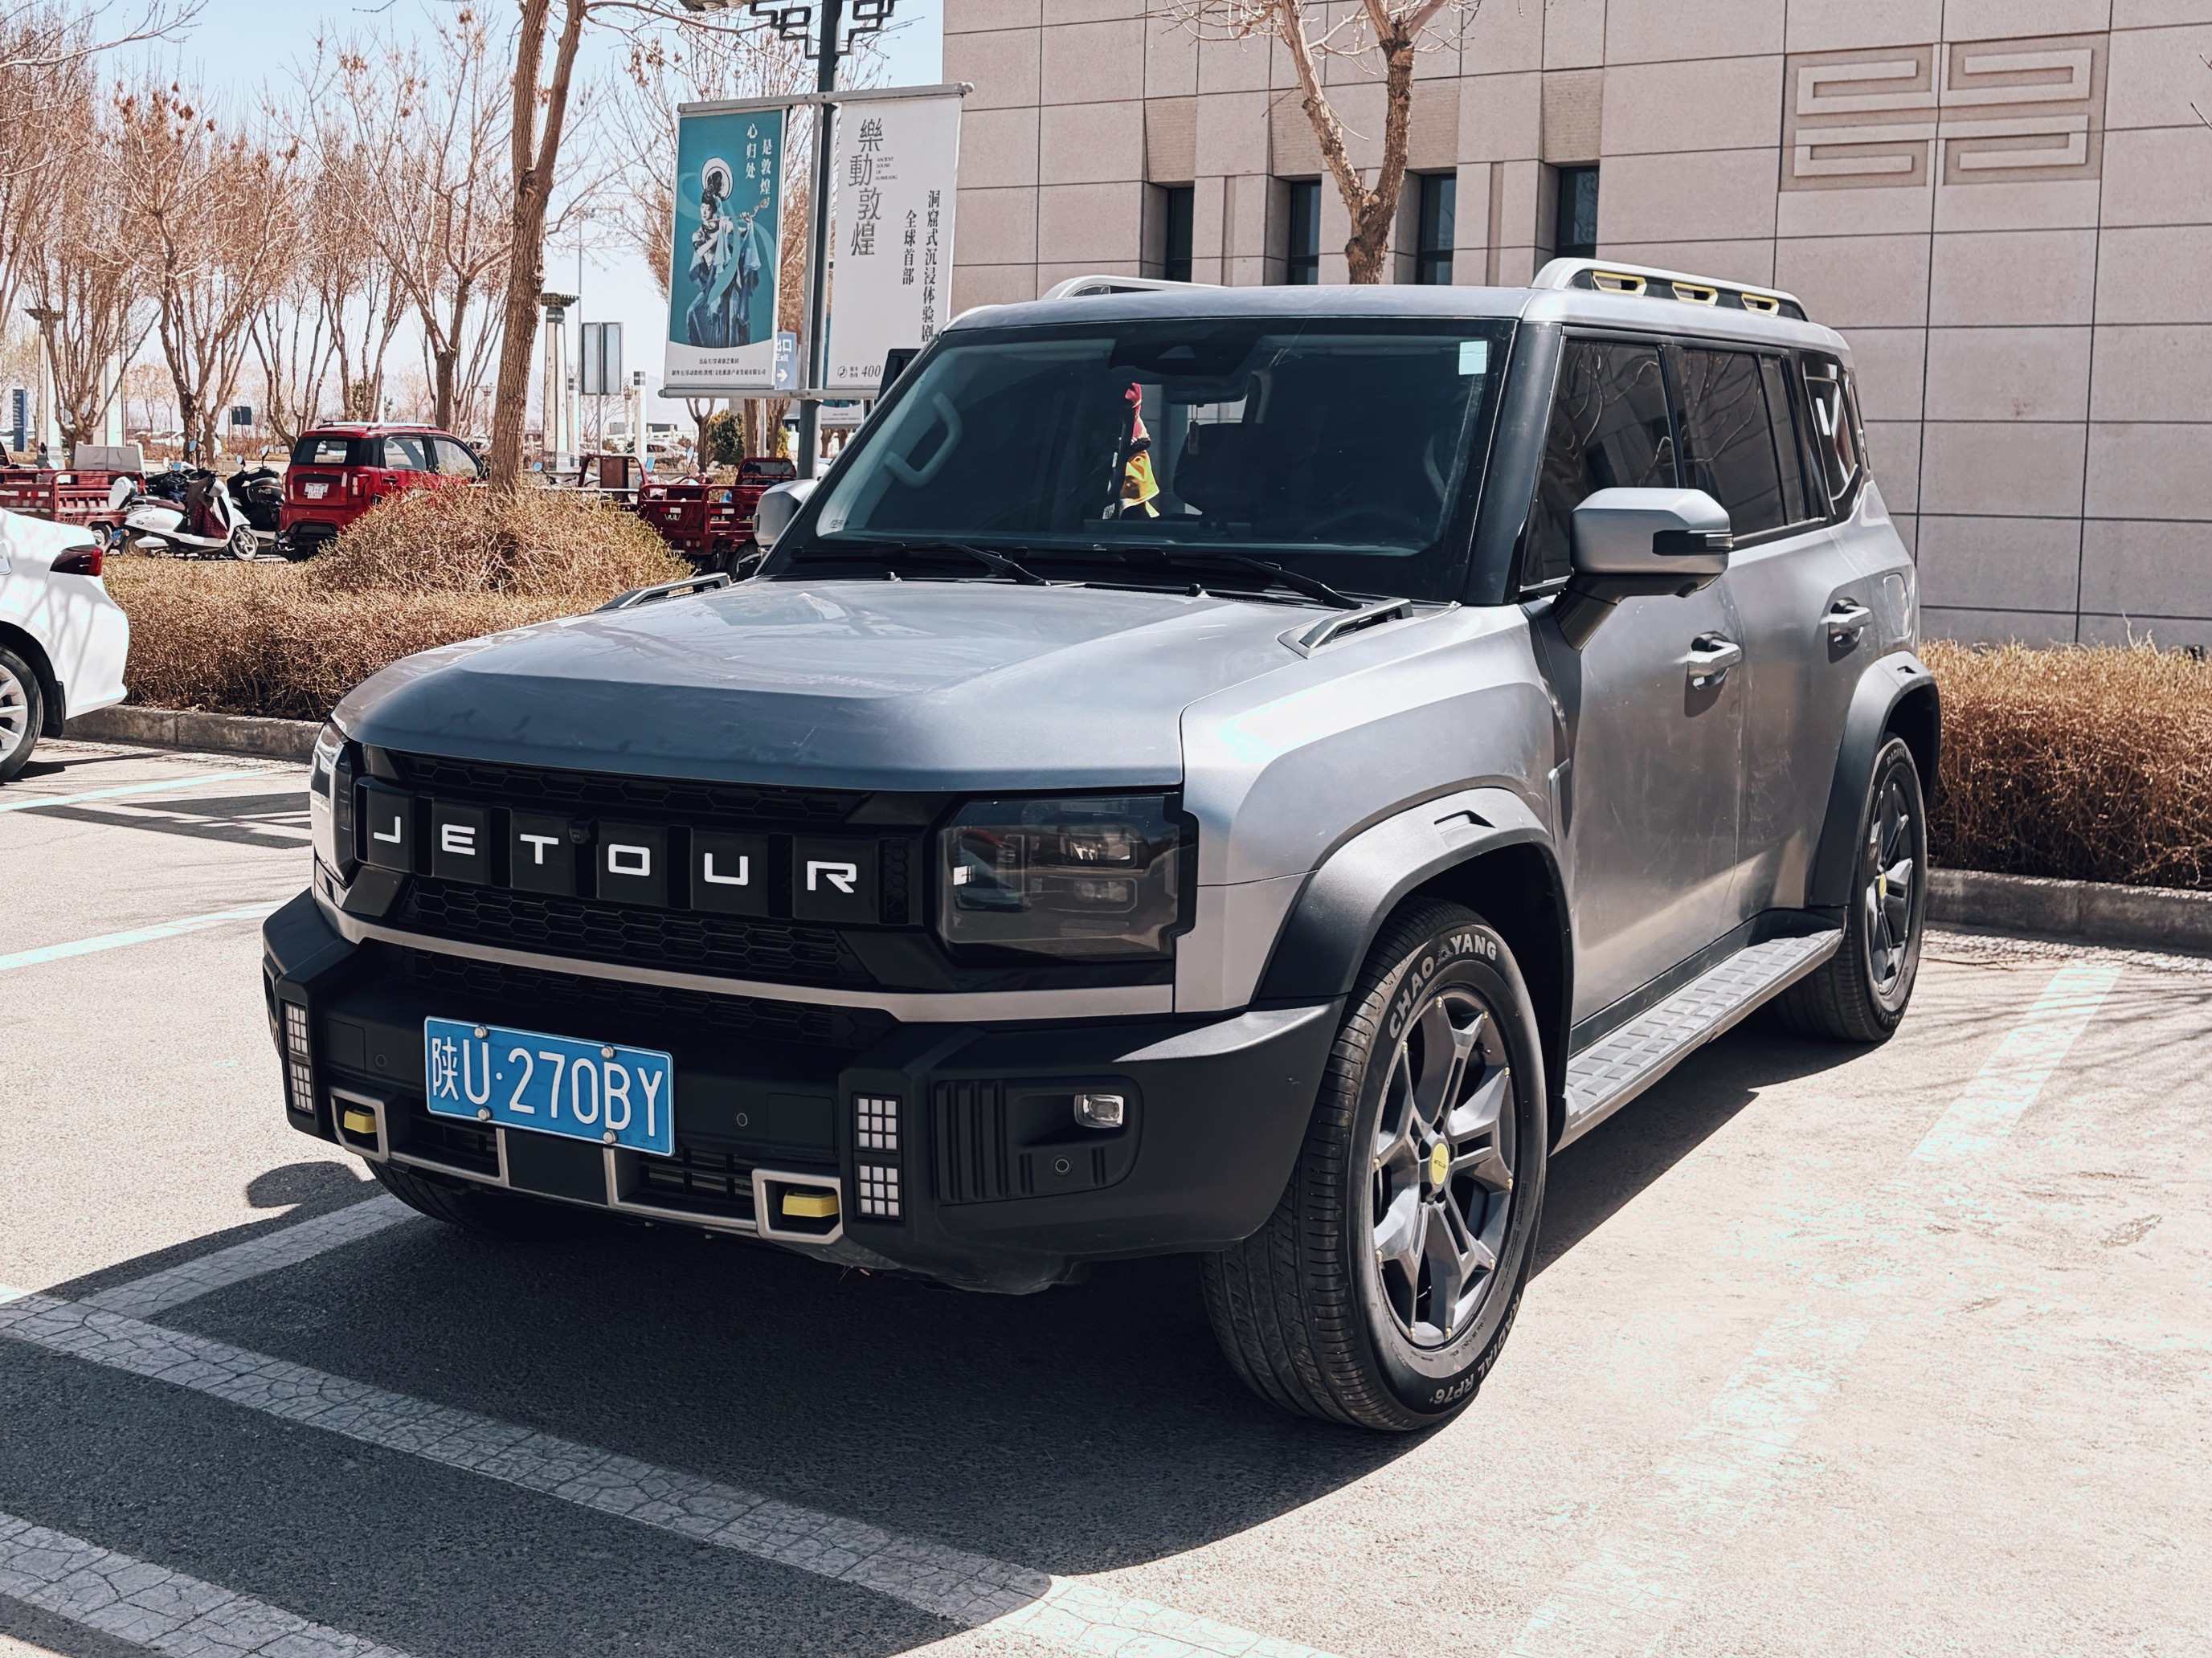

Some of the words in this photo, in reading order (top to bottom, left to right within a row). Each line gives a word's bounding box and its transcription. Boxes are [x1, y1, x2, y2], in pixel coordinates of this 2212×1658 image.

[745, 123, 758, 180] 心归处
[759, 139, 772, 196] 是敦煌
[848, 118, 883, 256] 樂動敦煌
[902, 210, 917, 286] 全球首部
[921, 190, 941, 343] 洞窟式沉浸体验剧
[861, 365, 881, 378] 400
[374, 816, 857, 893] JETOUR
[1389, 956, 1435, 1039] CHAO
[1449, 933, 1497, 961] YANG
